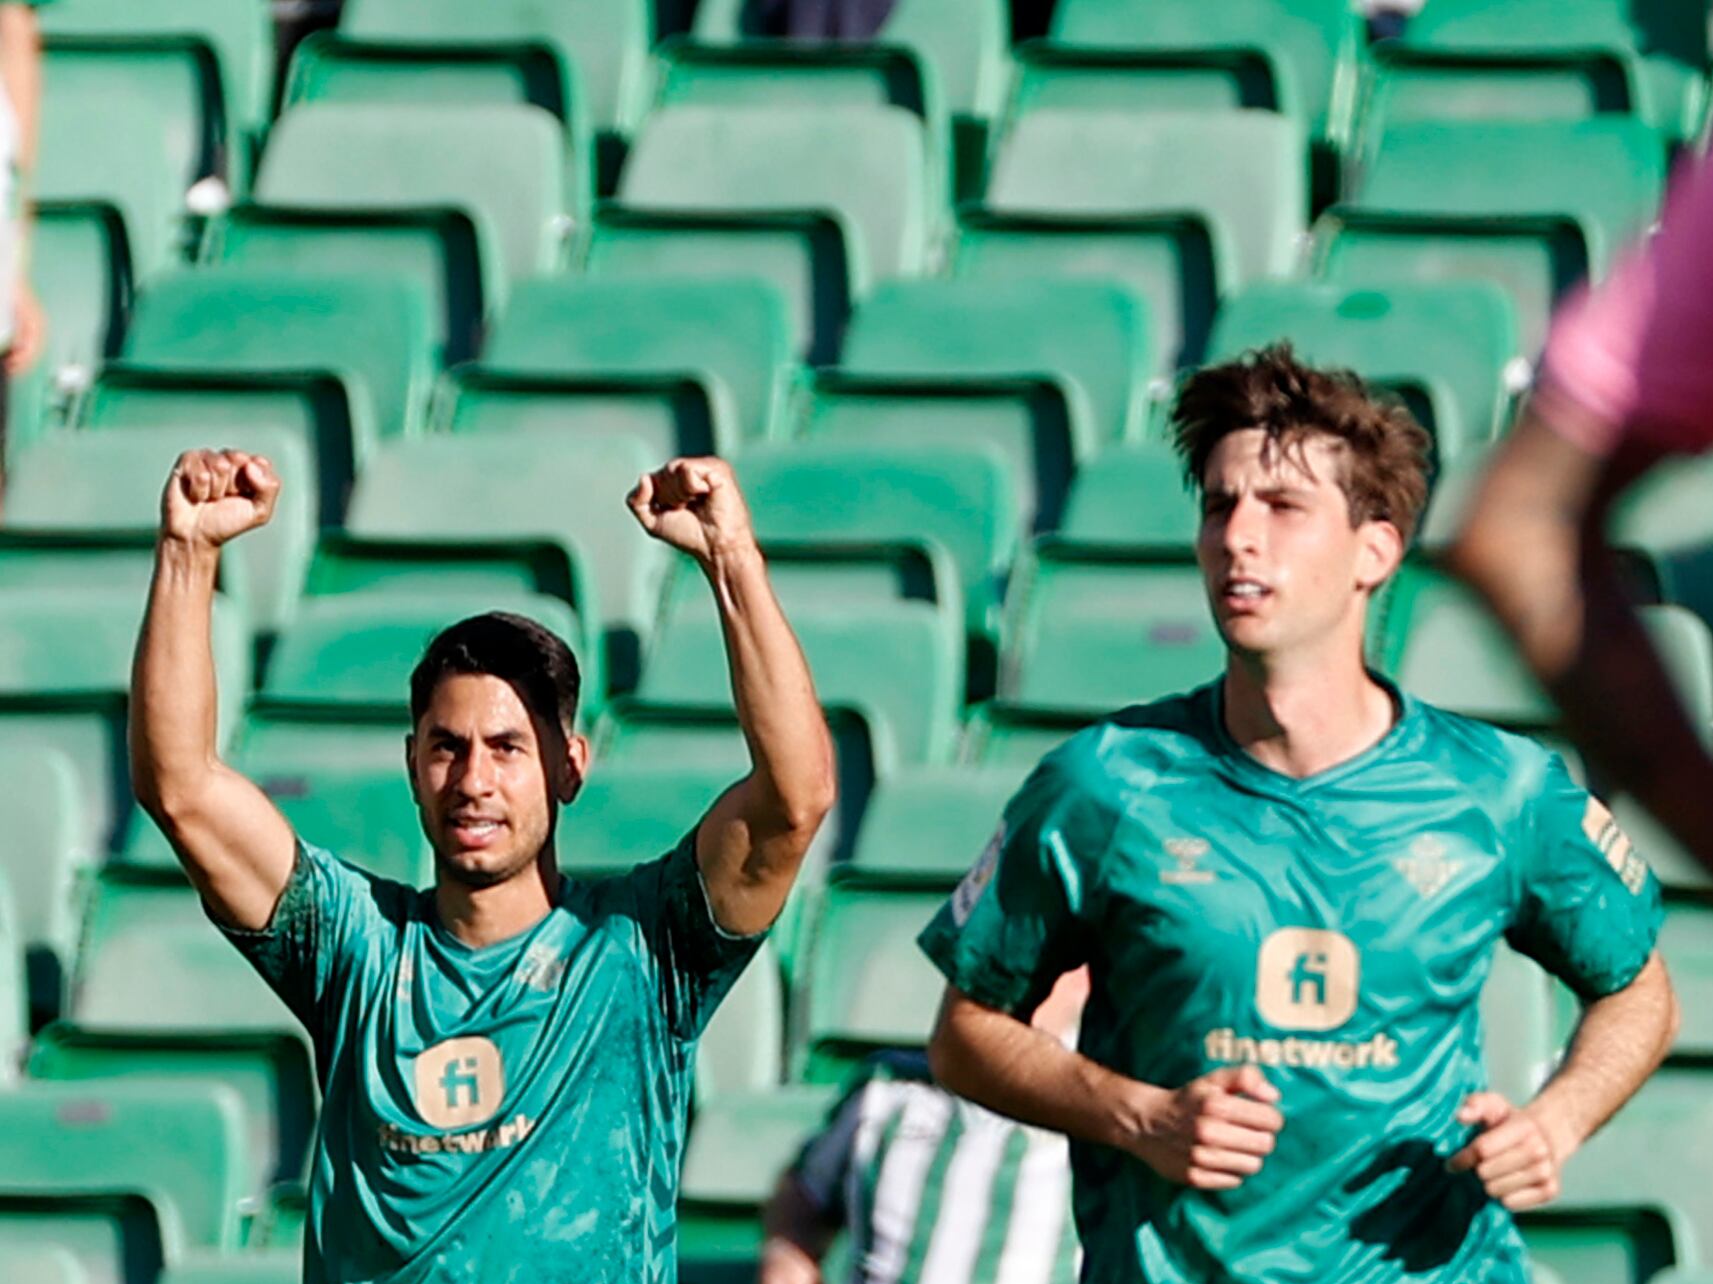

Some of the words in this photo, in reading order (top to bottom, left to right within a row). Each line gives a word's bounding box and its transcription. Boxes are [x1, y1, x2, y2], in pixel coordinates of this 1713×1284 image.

[1286, 952, 1328, 1006] fi
[1203, 1027, 1398, 1068] finetwork
[439, 1057, 480, 1110] fi
